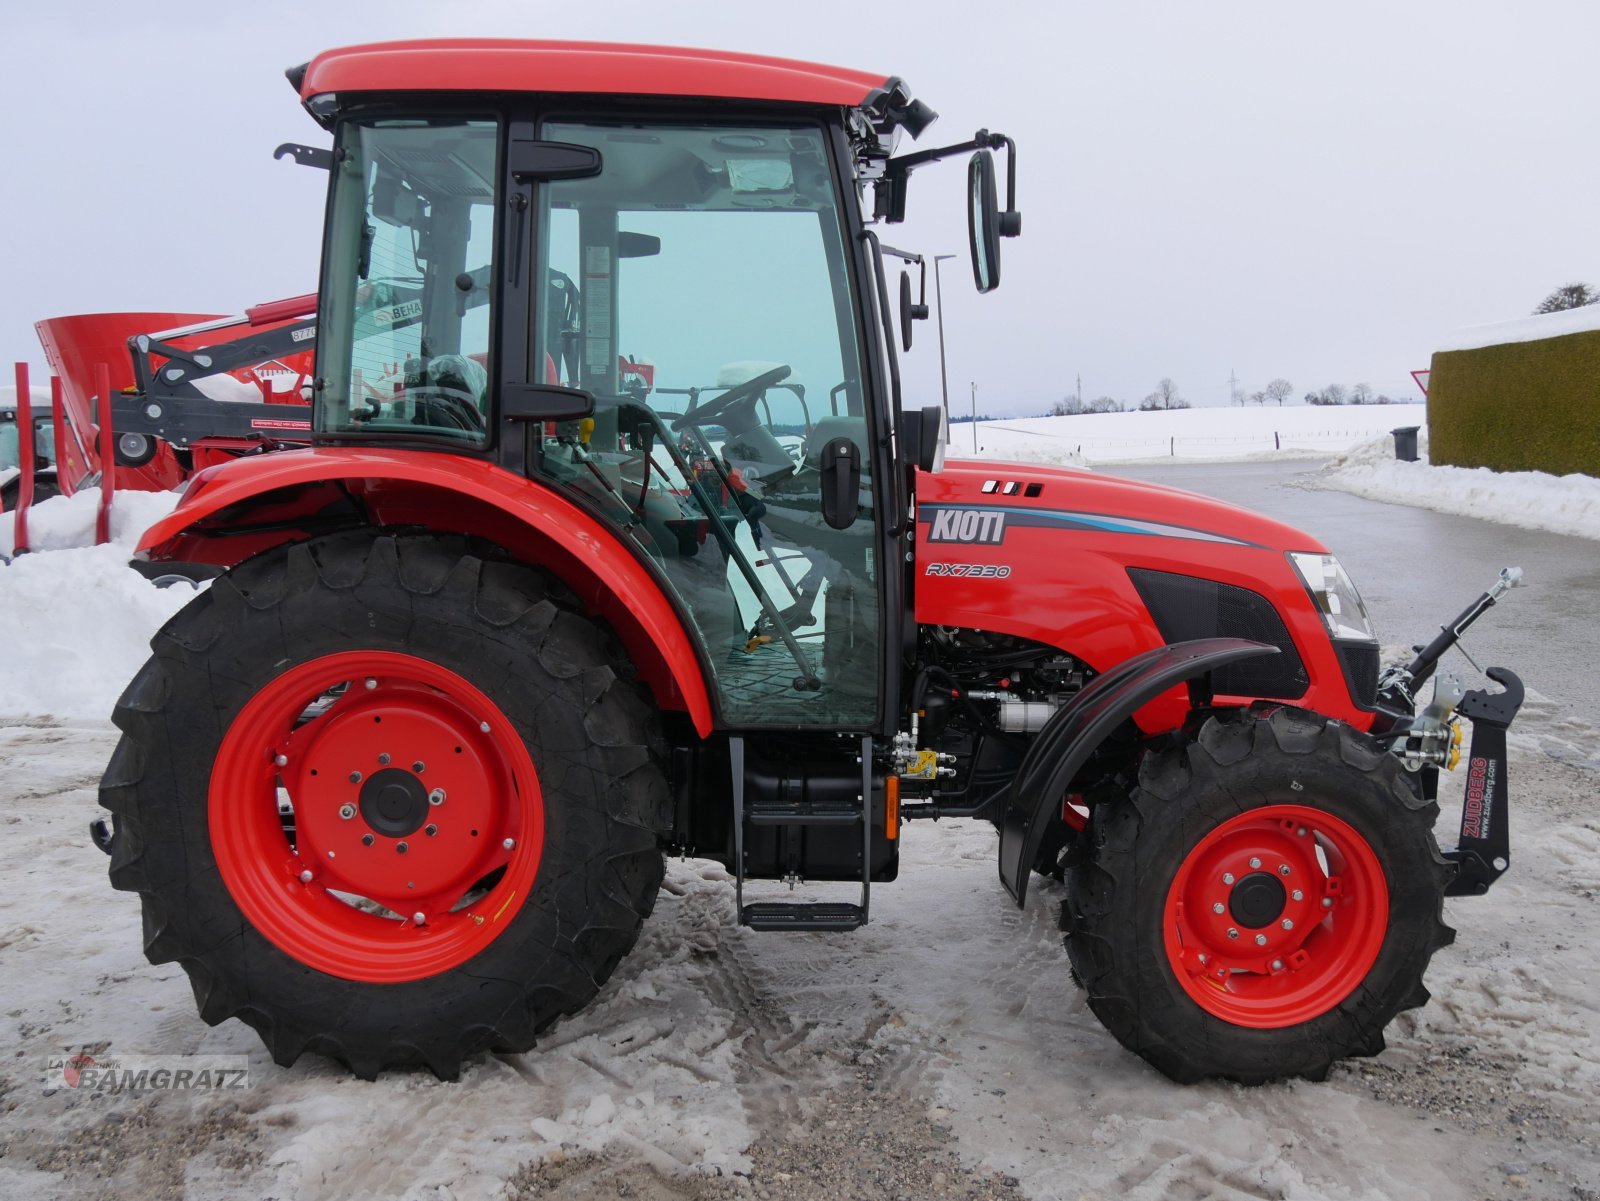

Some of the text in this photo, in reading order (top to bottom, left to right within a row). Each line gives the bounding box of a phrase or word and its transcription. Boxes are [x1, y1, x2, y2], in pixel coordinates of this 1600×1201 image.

[931, 509, 1005, 542] KIOTI
[925, 563, 1011, 578] RX7330
[1463, 757, 1488, 838] ZUIDBERG
[1481, 759, 1497, 839] www.zuidberg.com
